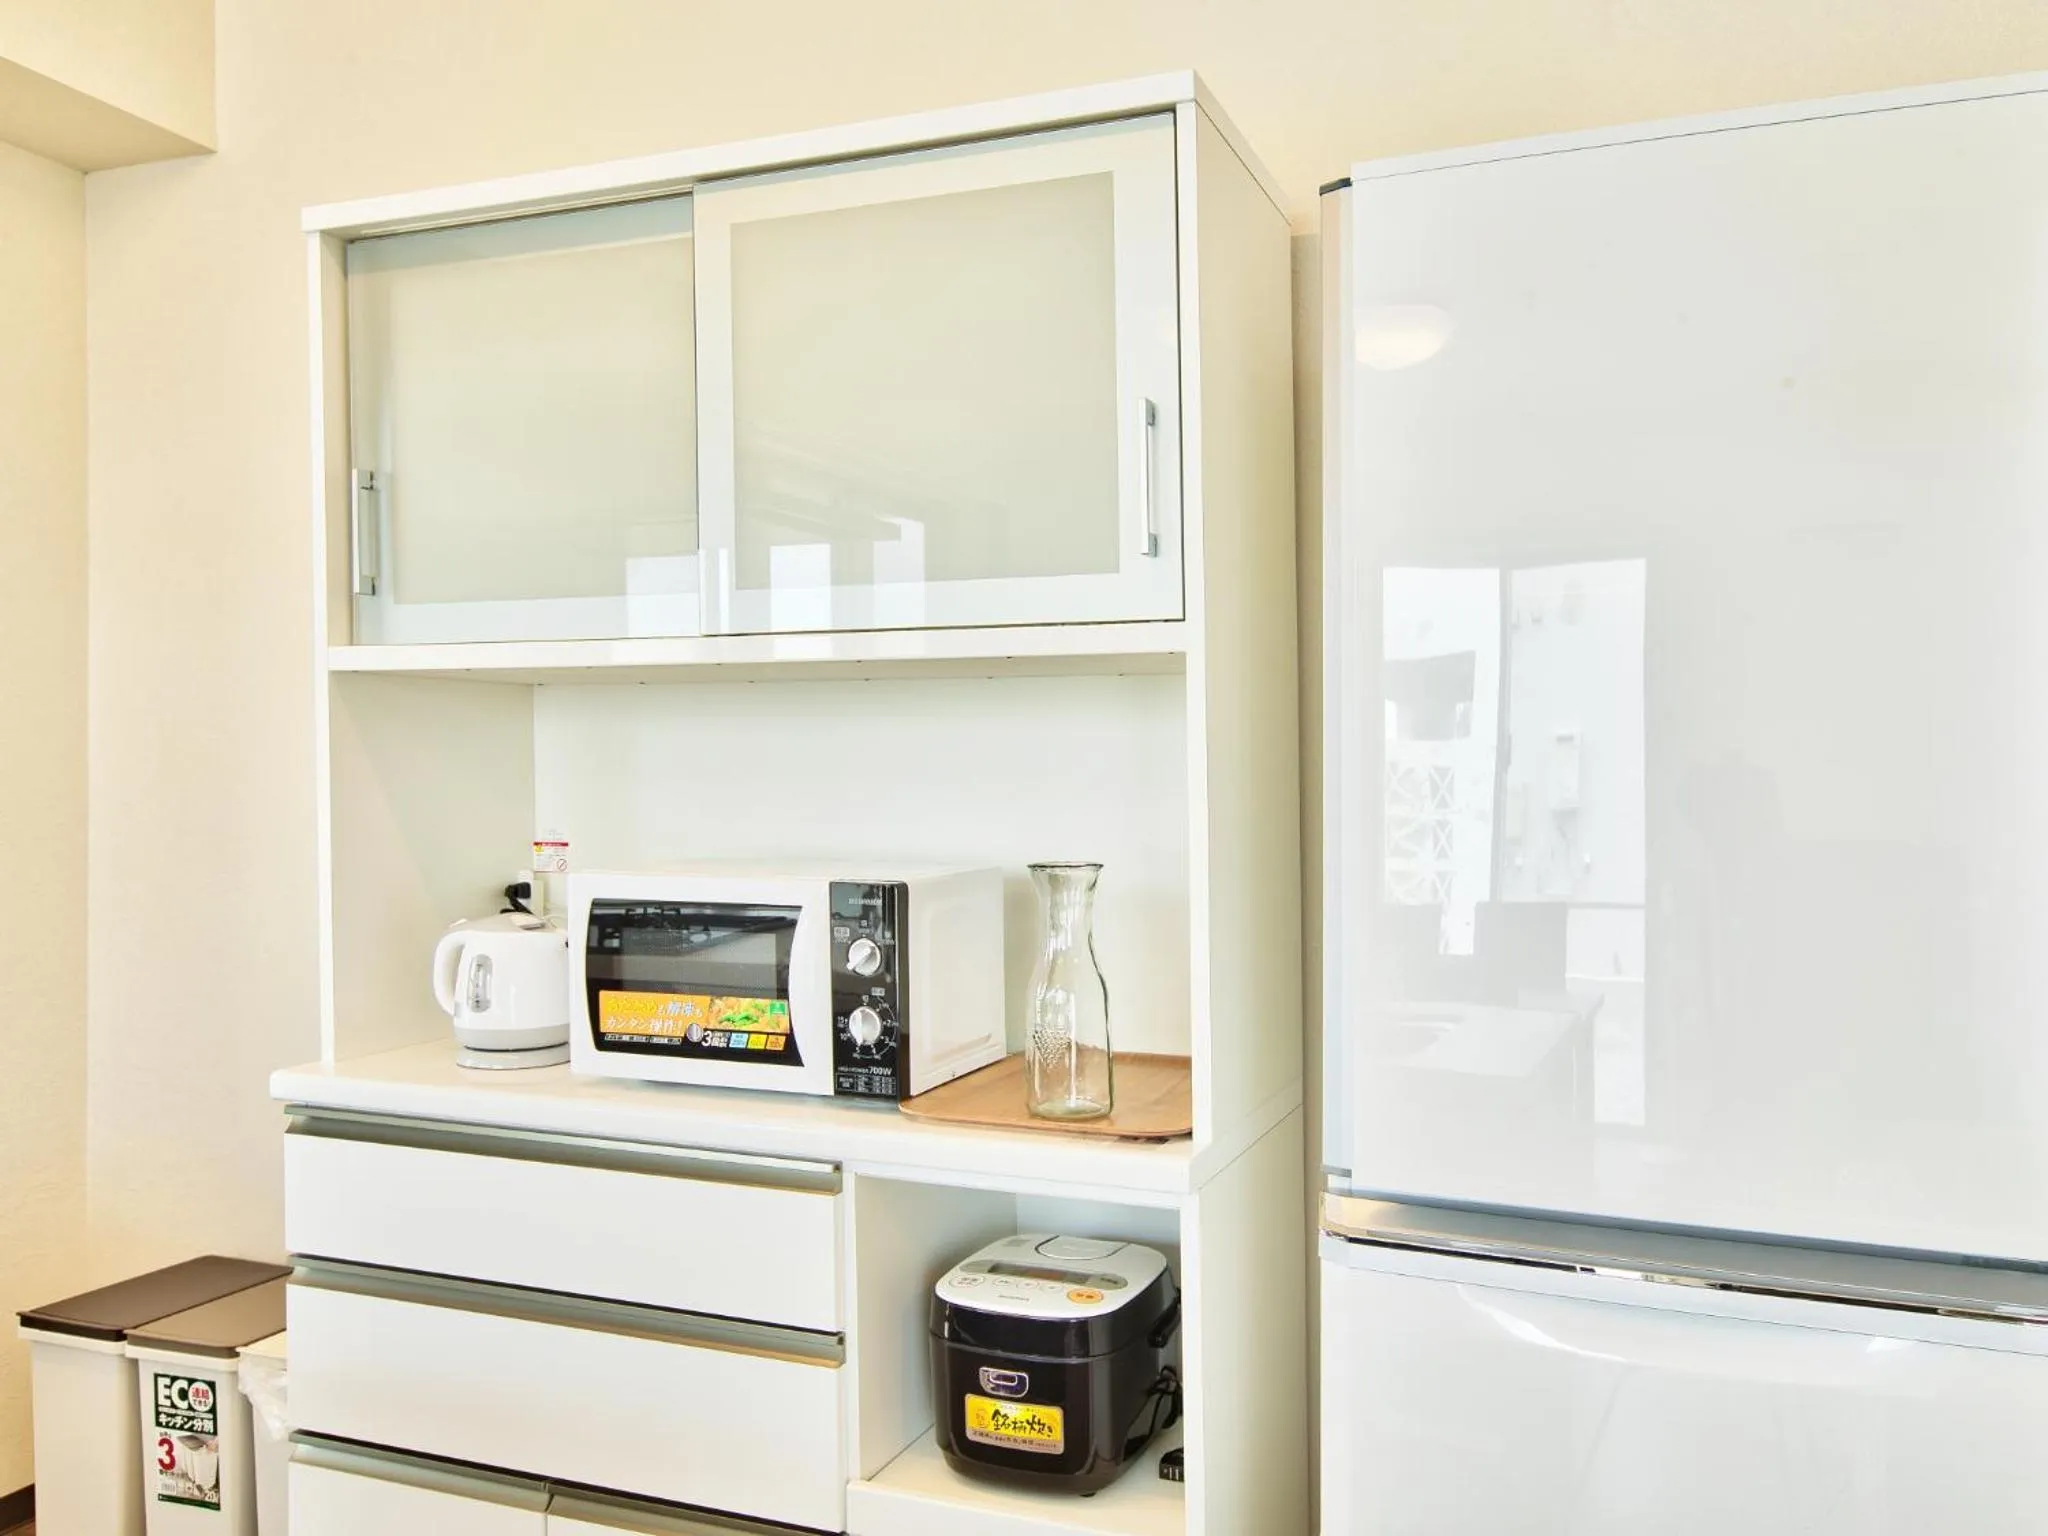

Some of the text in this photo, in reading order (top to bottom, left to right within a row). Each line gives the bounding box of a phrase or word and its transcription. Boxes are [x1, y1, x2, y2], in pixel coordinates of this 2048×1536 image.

[701, 1030, 713, 1047] 3
[869, 1066, 893, 1075] 700W
[158, 1412, 214, 1433] キッチン分別
[158, 1437, 176, 1471] 3
